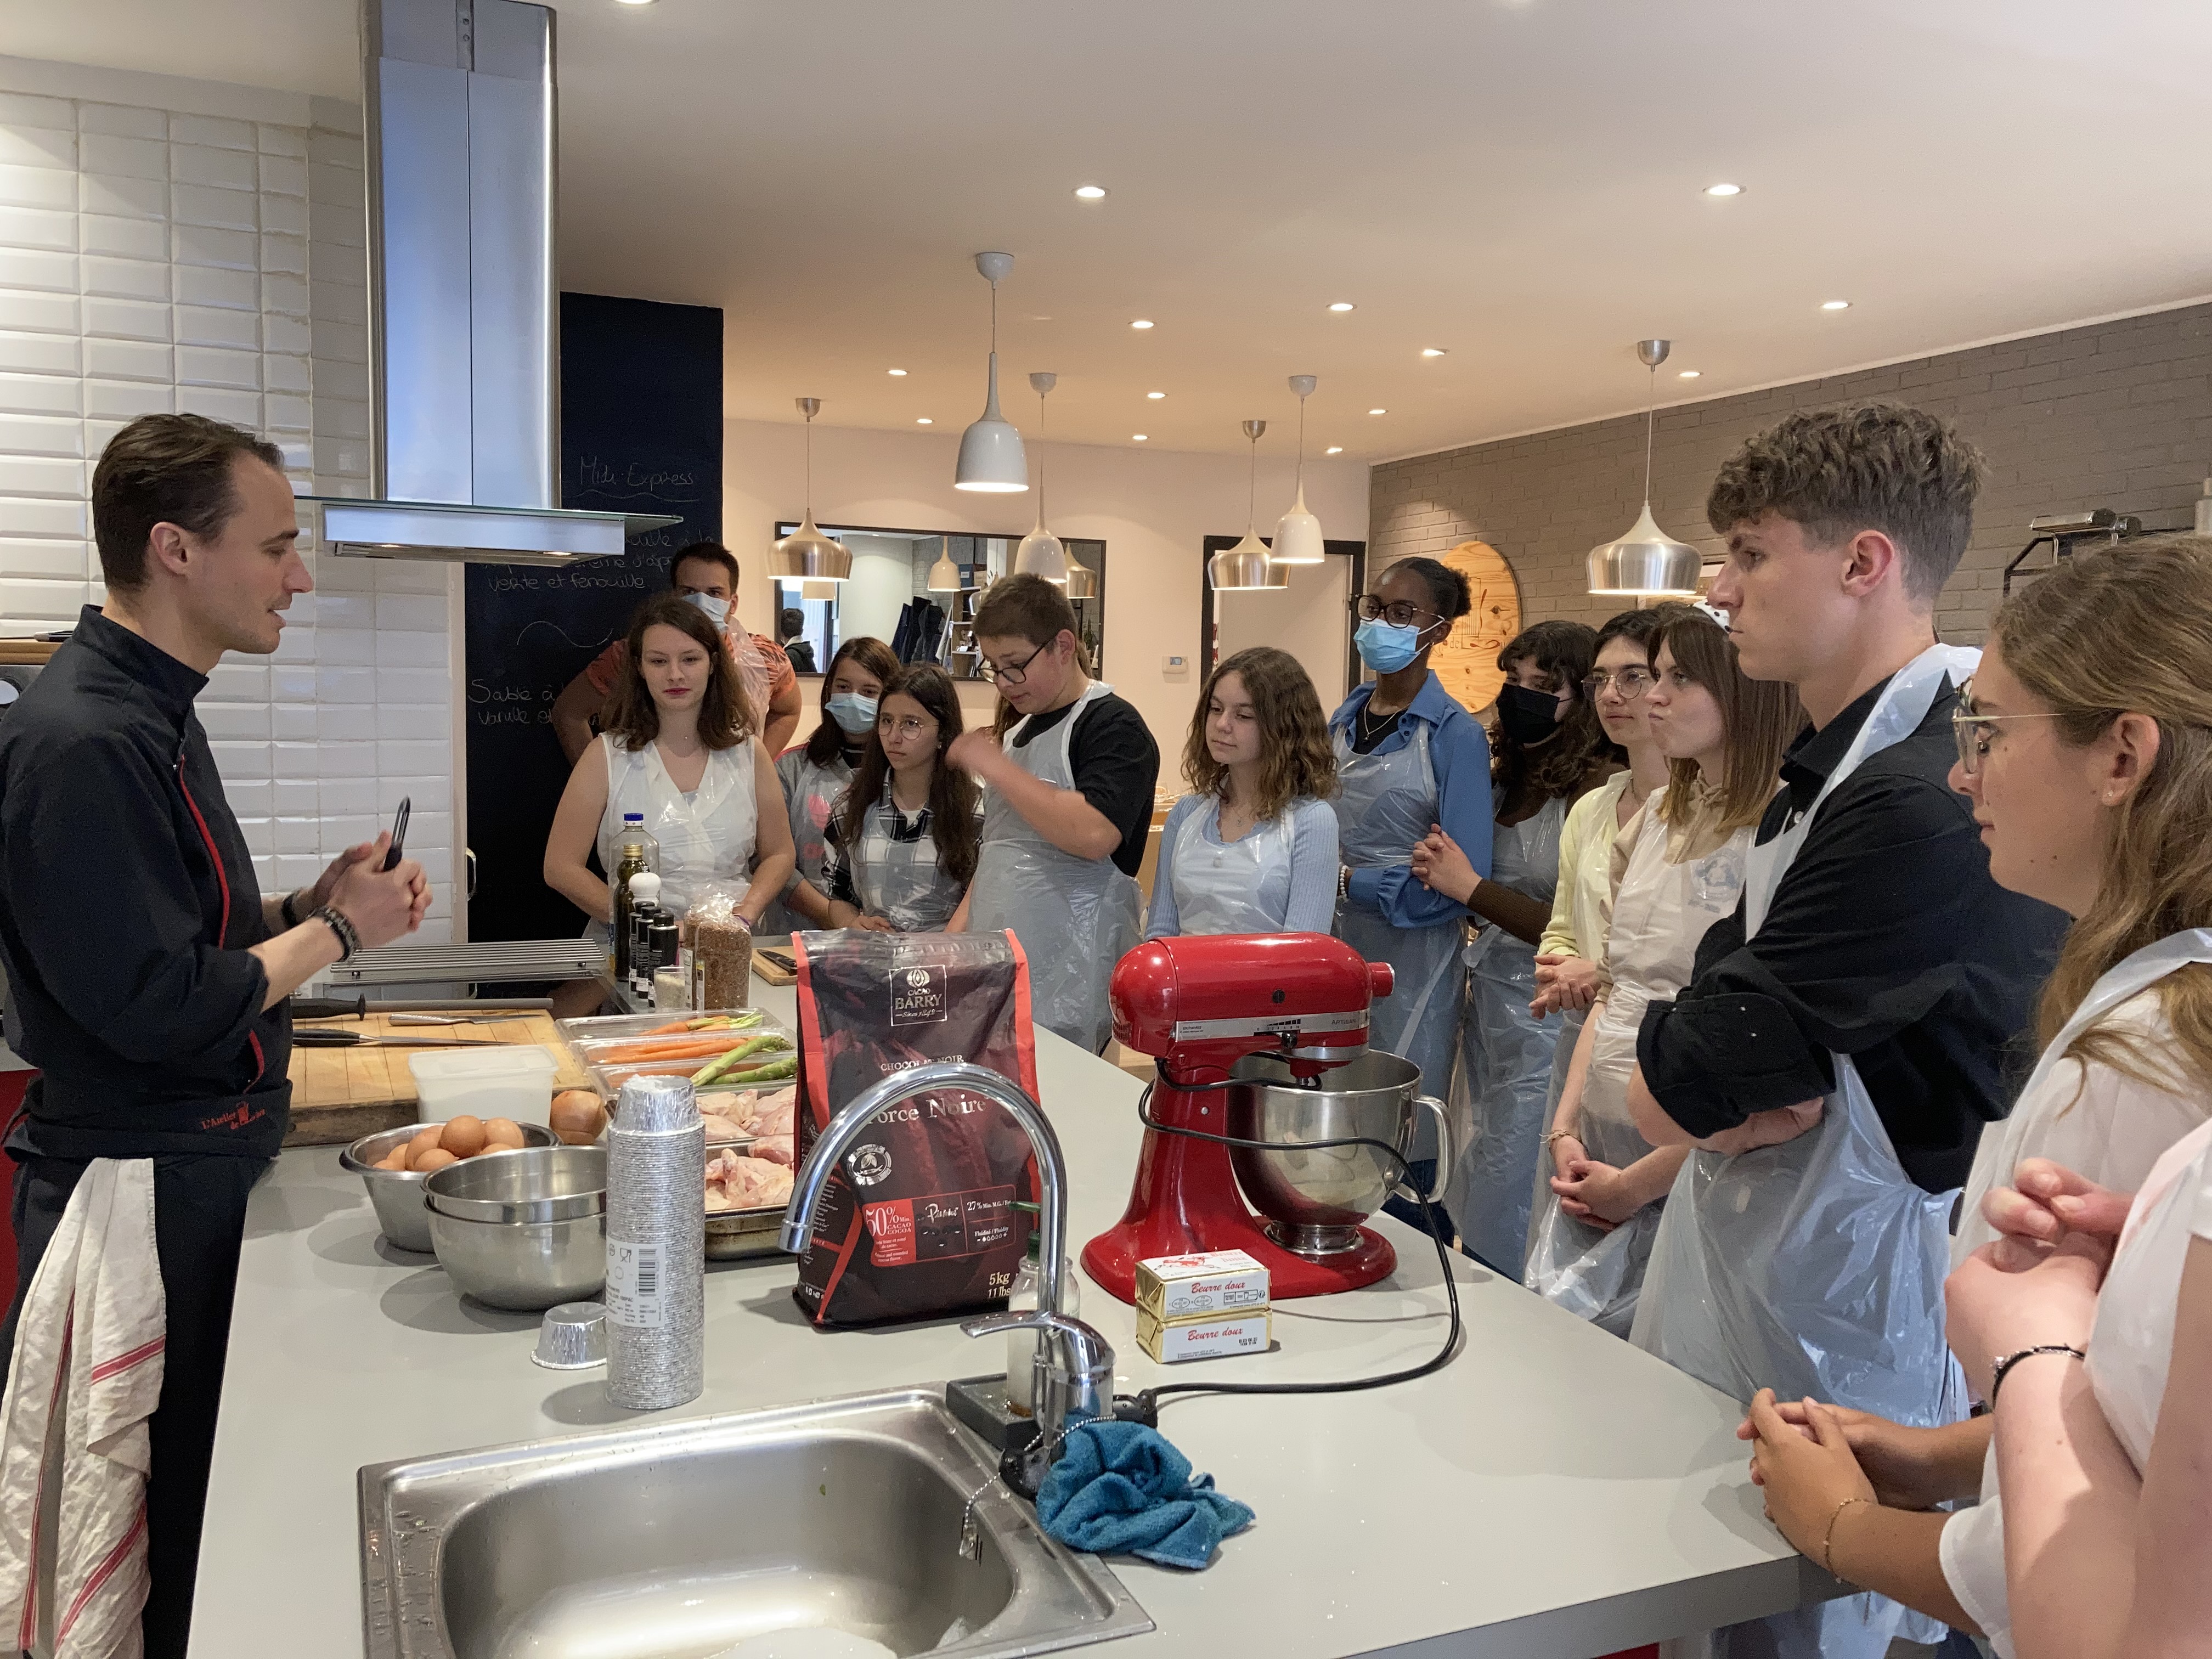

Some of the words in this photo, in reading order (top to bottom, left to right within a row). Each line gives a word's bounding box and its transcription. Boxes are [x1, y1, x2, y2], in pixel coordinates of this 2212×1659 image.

[627, 462, 693, 492] Express
[548, 574, 566, 588] et
[895, 994, 942, 1009] BARRY
[867, 1108, 919, 1124] orce
[1192, 1282, 1222, 1294] Beurre
[1225, 1280, 1246, 1290] doux
[1188, 1329, 1218, 1340] Beurre
[1222, 1327, 1243, 1336] doux
